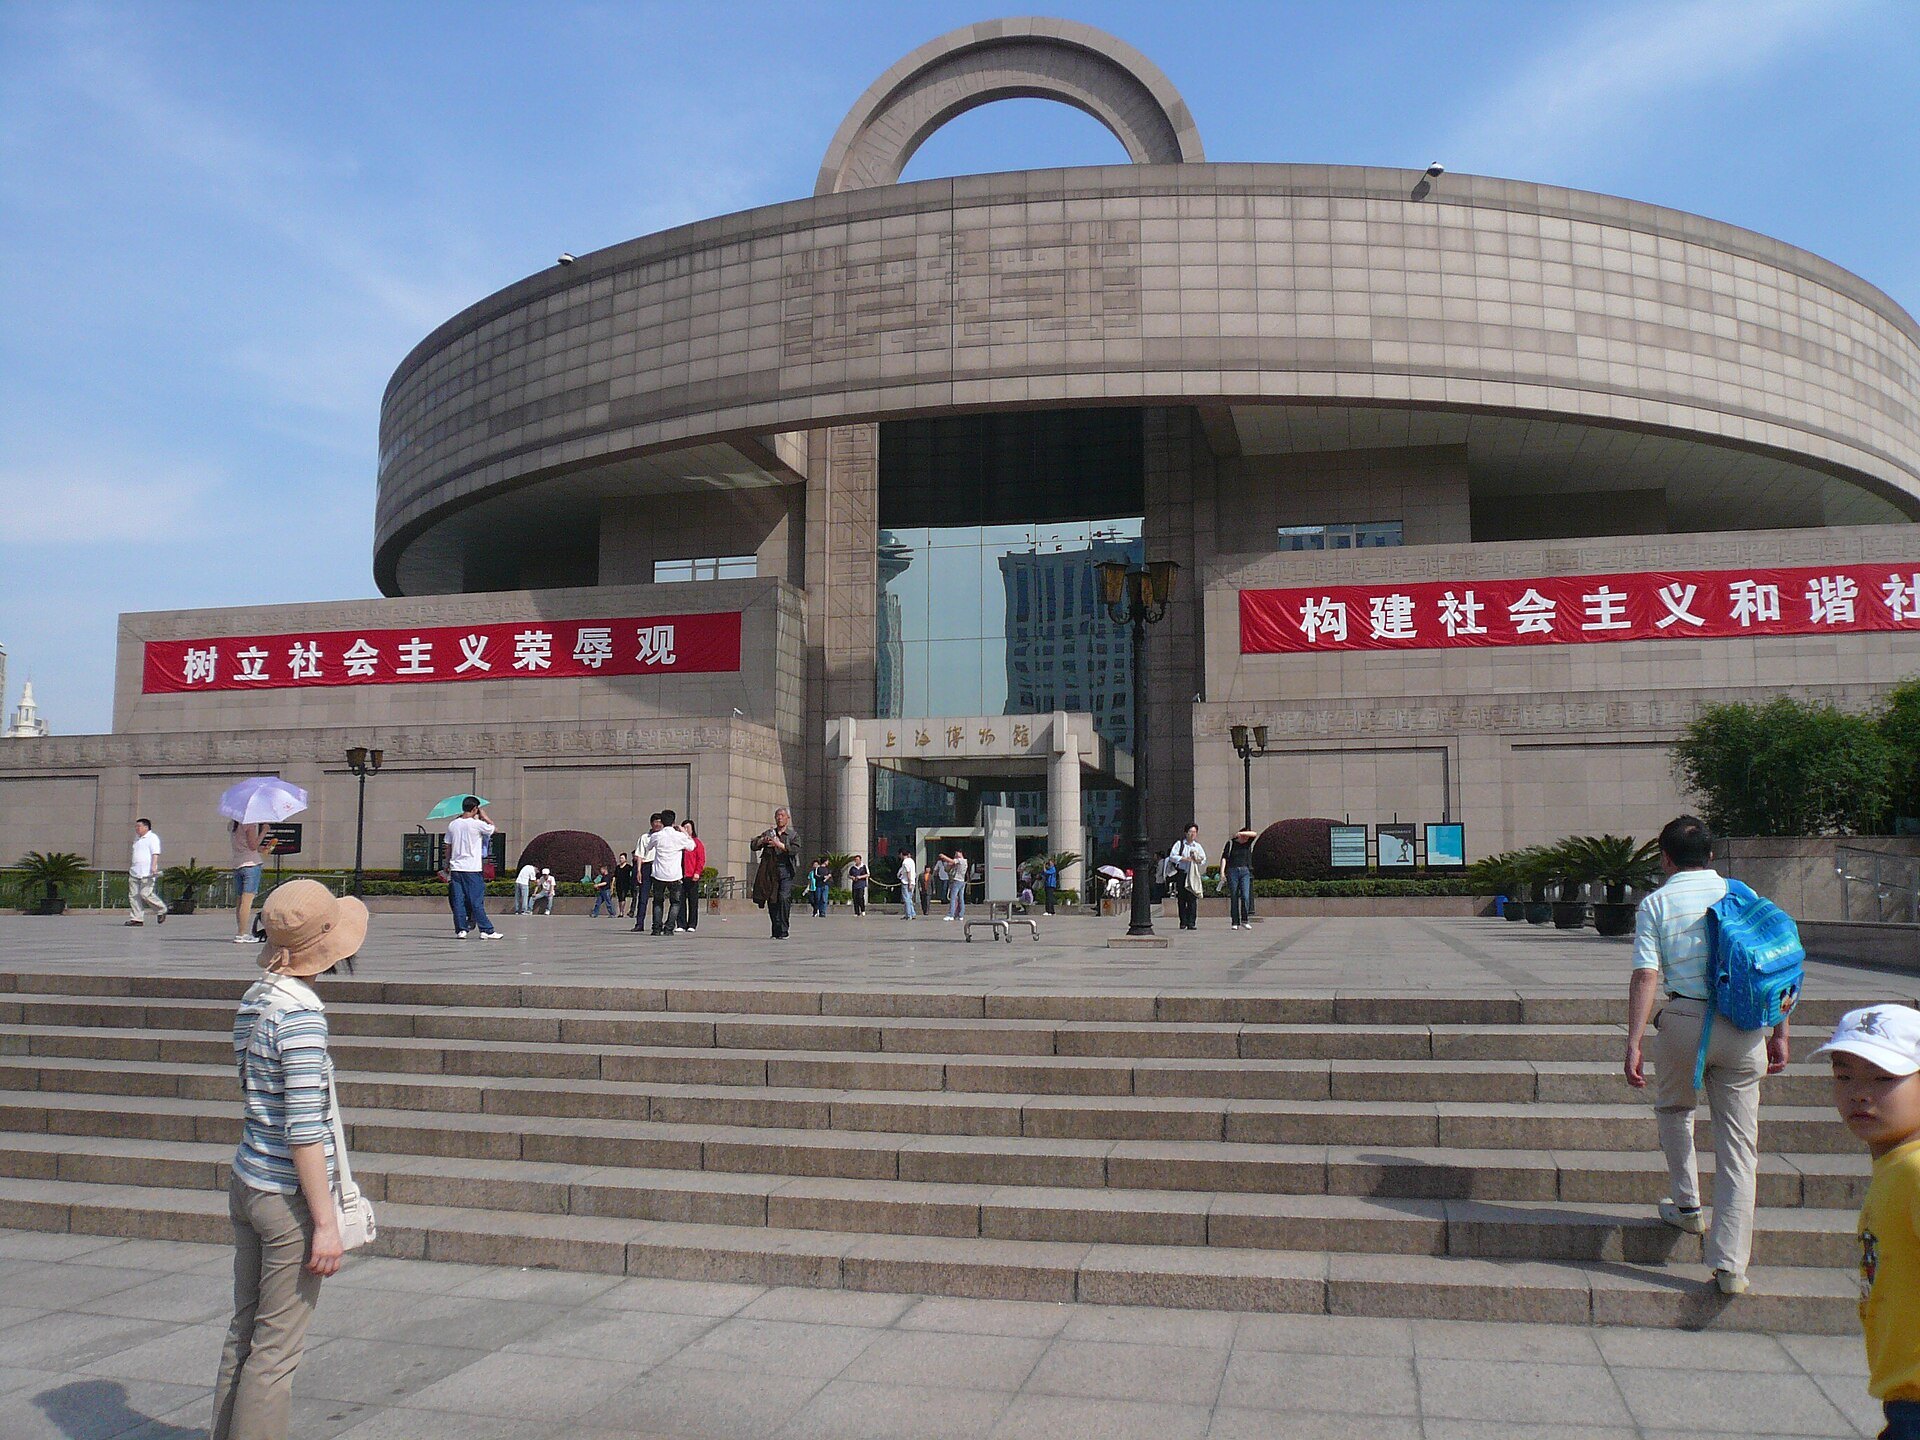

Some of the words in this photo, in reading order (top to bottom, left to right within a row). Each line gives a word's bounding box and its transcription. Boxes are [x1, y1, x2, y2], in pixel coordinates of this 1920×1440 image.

[1299, 572, 1920, 643] 构建社会主义和谐社
[182, 625, 677, 684] 树立社会主义荣辱观
